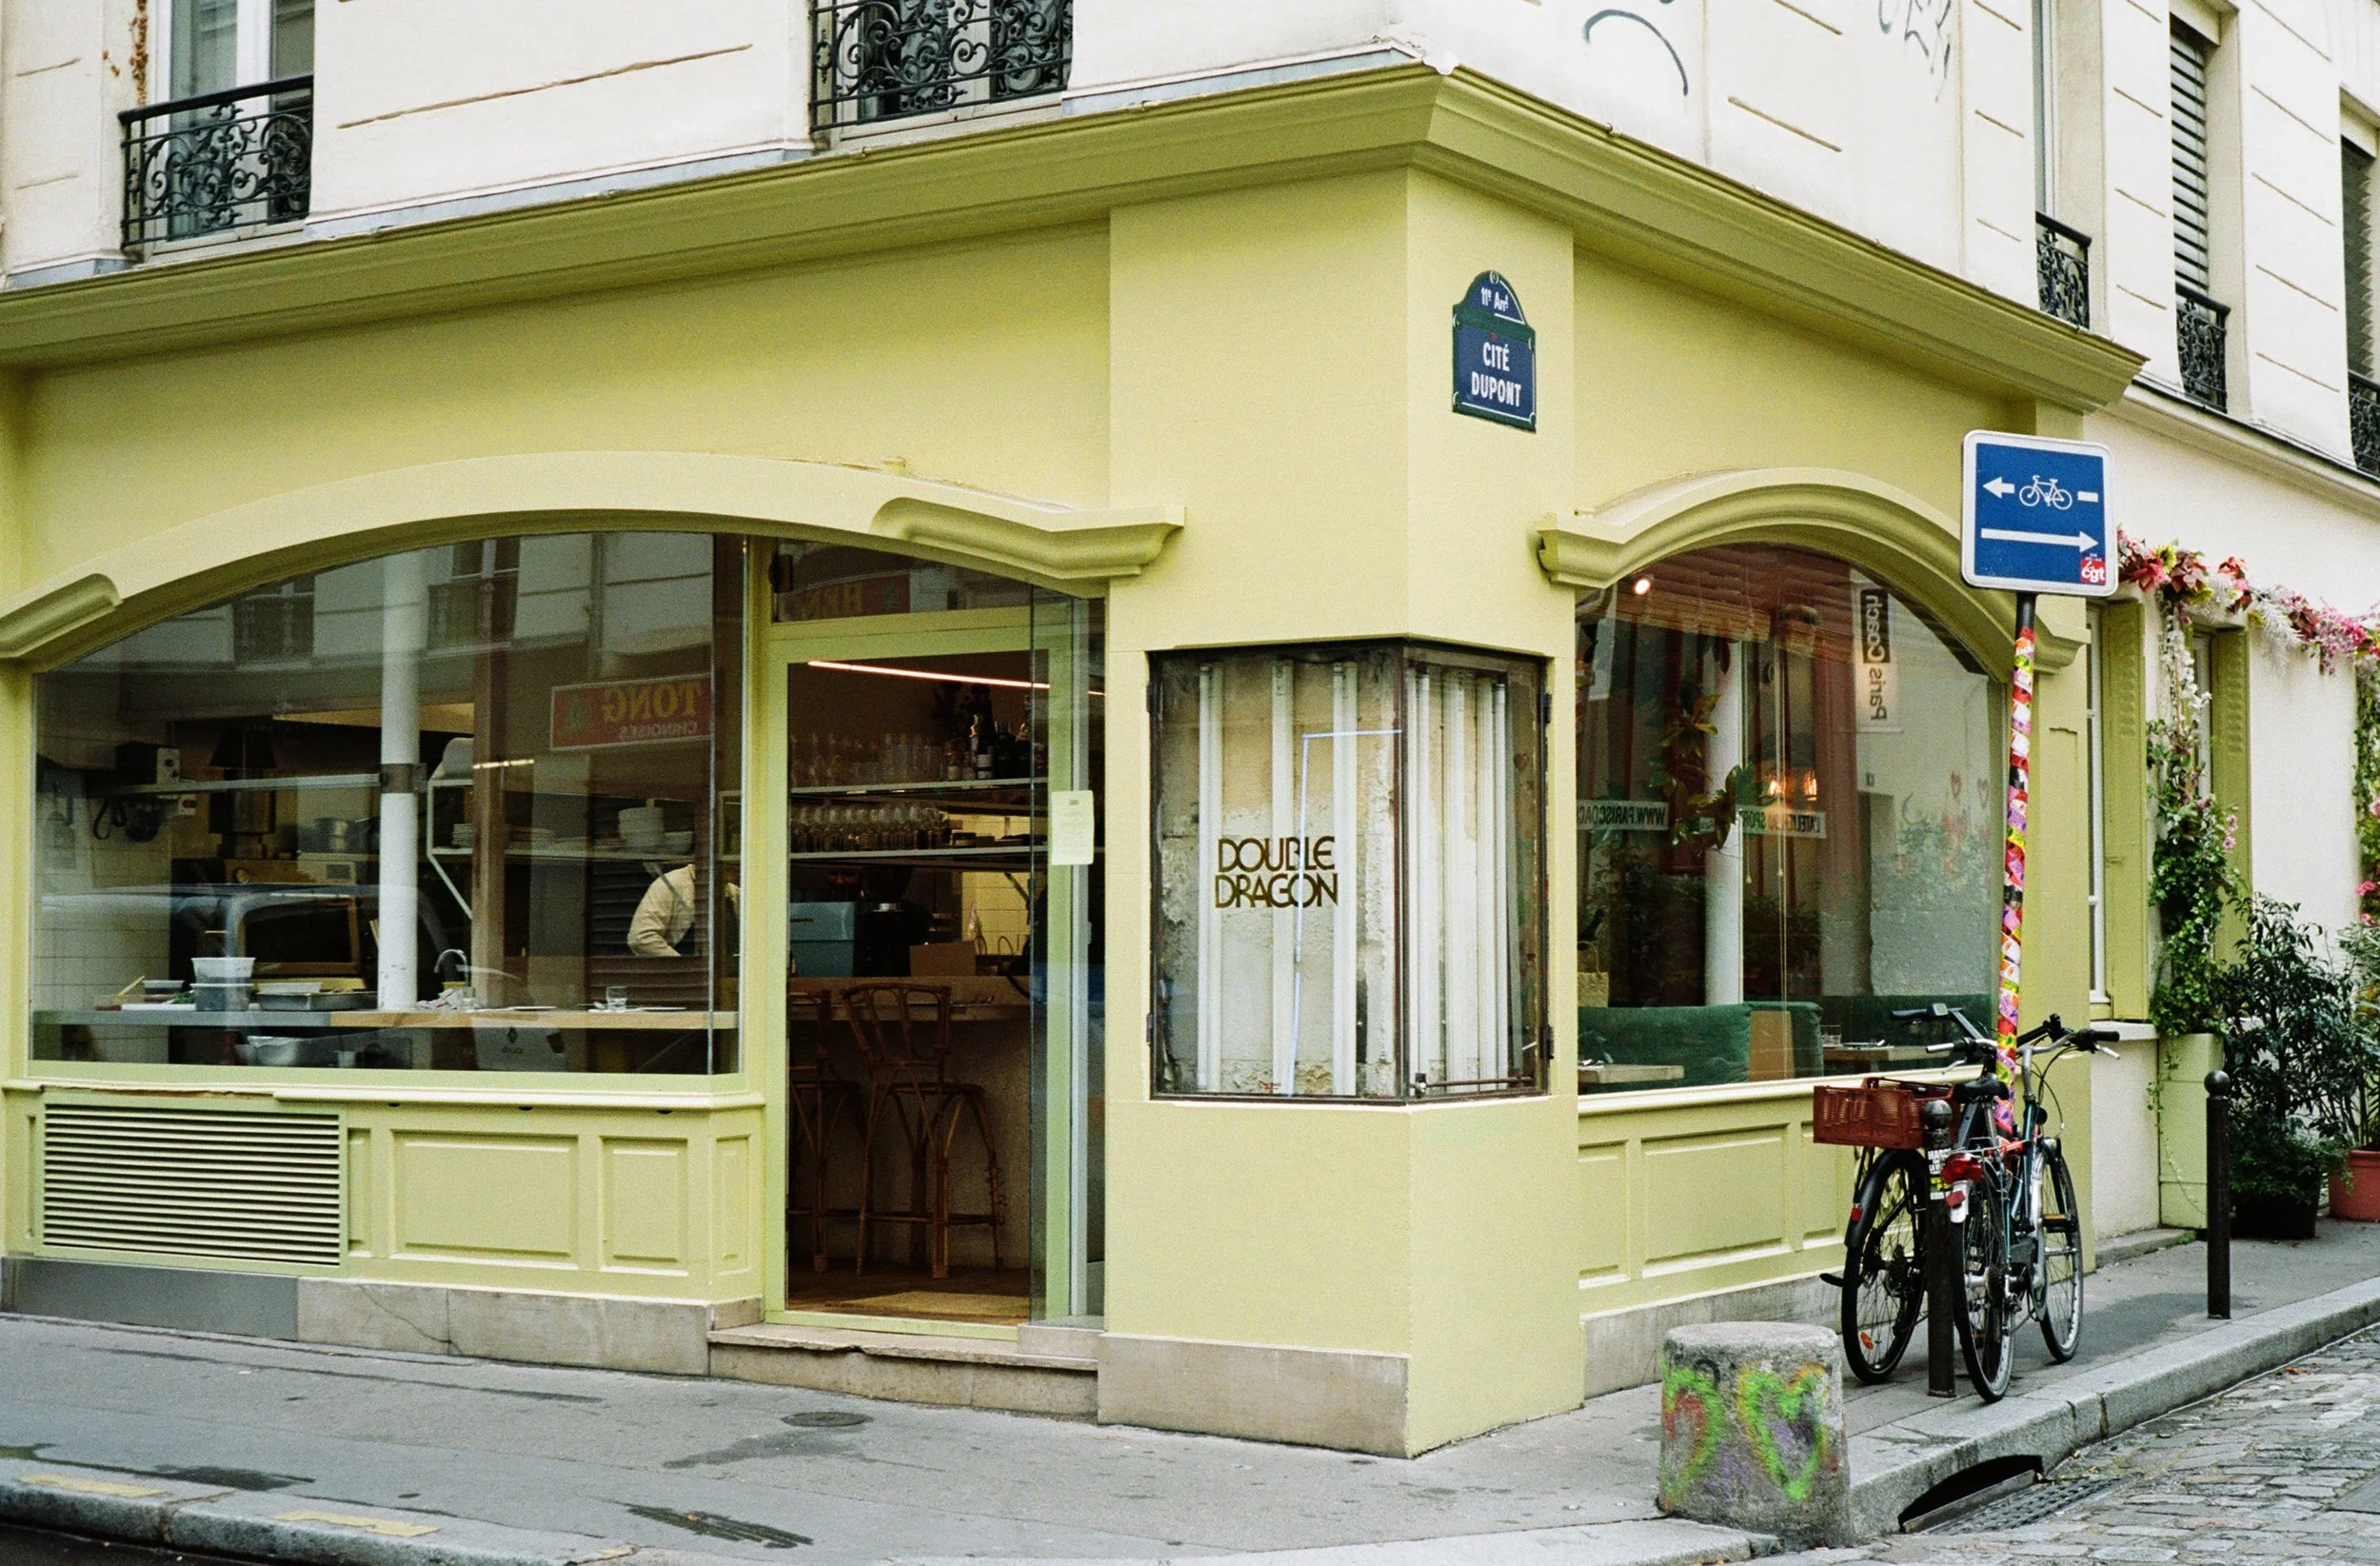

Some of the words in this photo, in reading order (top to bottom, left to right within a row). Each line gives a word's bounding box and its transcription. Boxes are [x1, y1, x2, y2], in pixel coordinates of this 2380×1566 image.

[1483, 342, 1510, 372] CITÉ
[1472, 371, 1521, 406] DUPONT
[1219, 836, 1335, 872] DOUBLE
[1215, 873, 1338, 908] DRAGON
